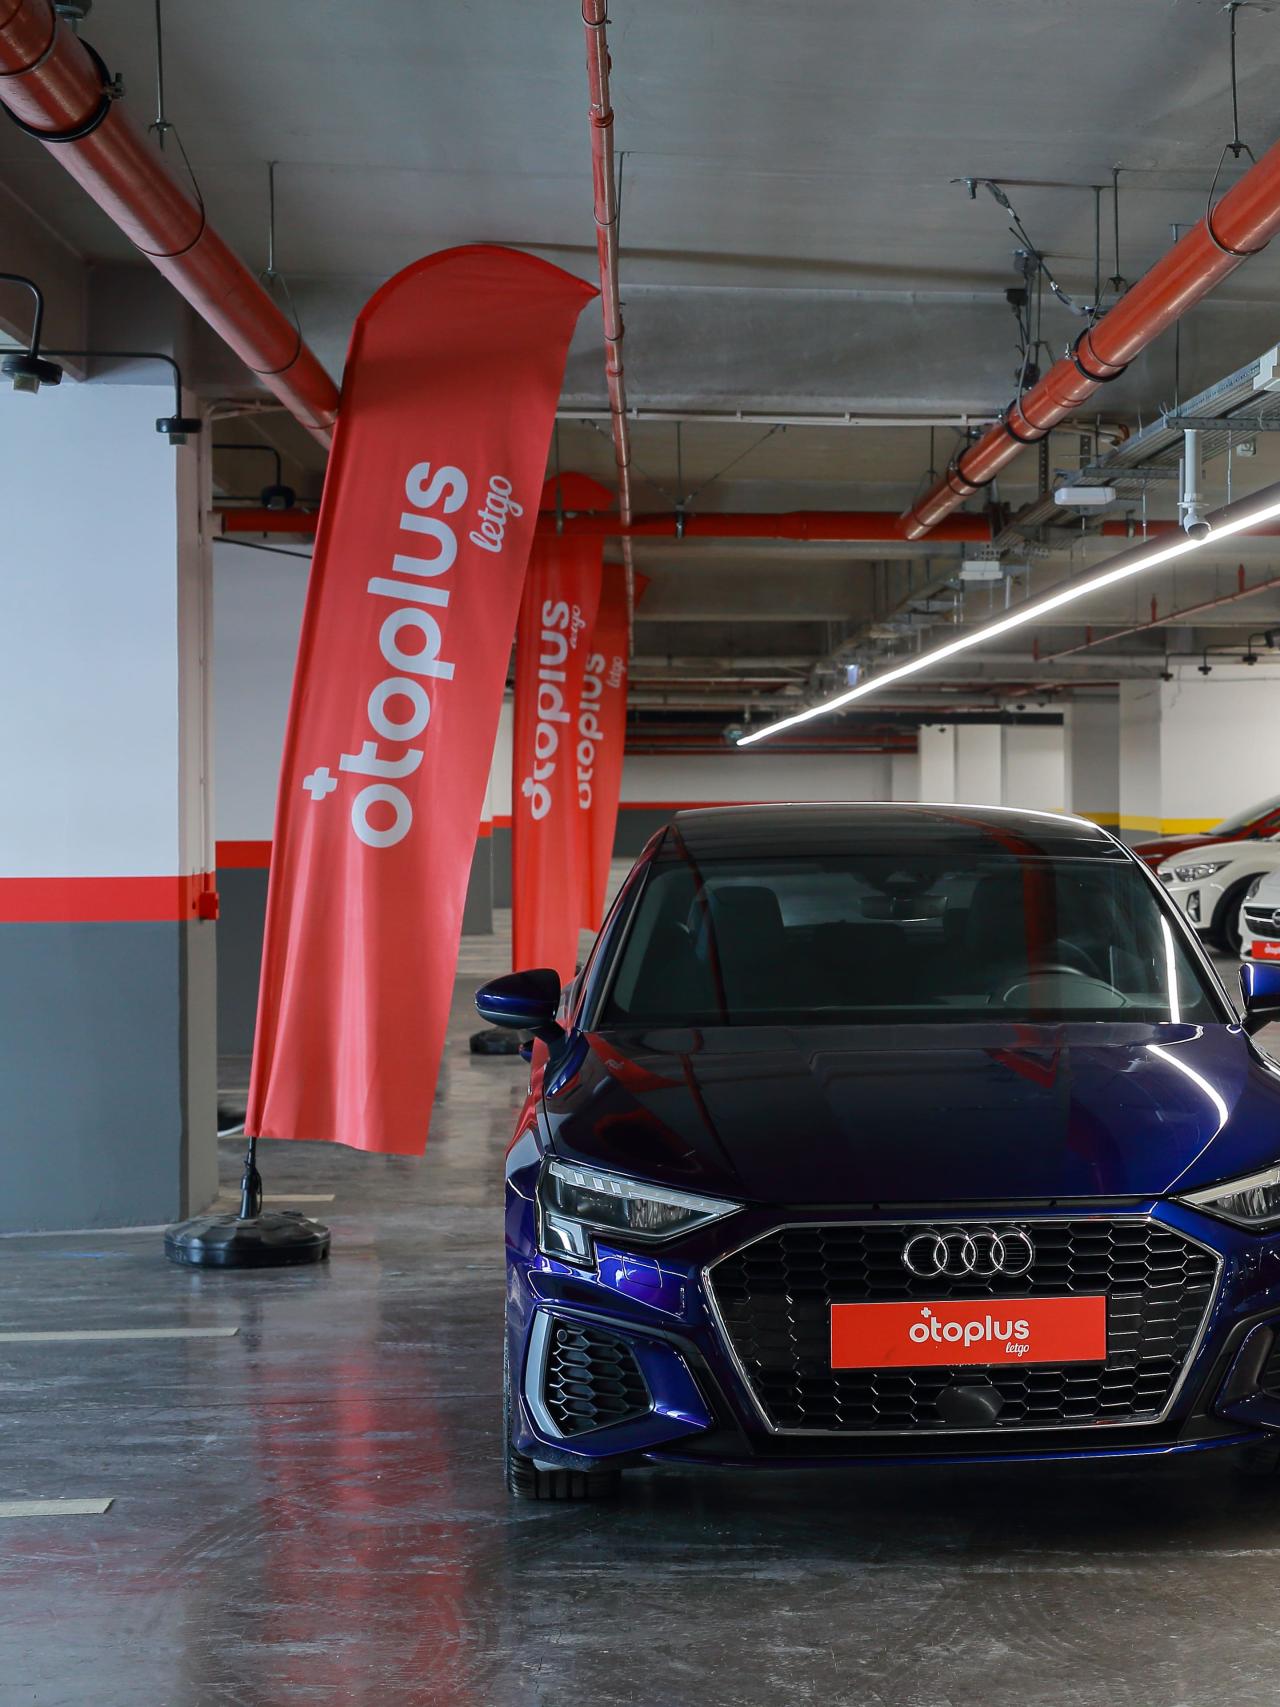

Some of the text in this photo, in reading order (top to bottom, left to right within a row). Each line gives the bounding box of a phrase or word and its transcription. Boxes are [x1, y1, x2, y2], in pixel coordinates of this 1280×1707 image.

[469, 475, 523, 552] letgo
[339, 461, 469, 848] otoplus
[909, 1315, 1030, 1347] otoplus
[1005, 1341, 1030, 1357] letgo
